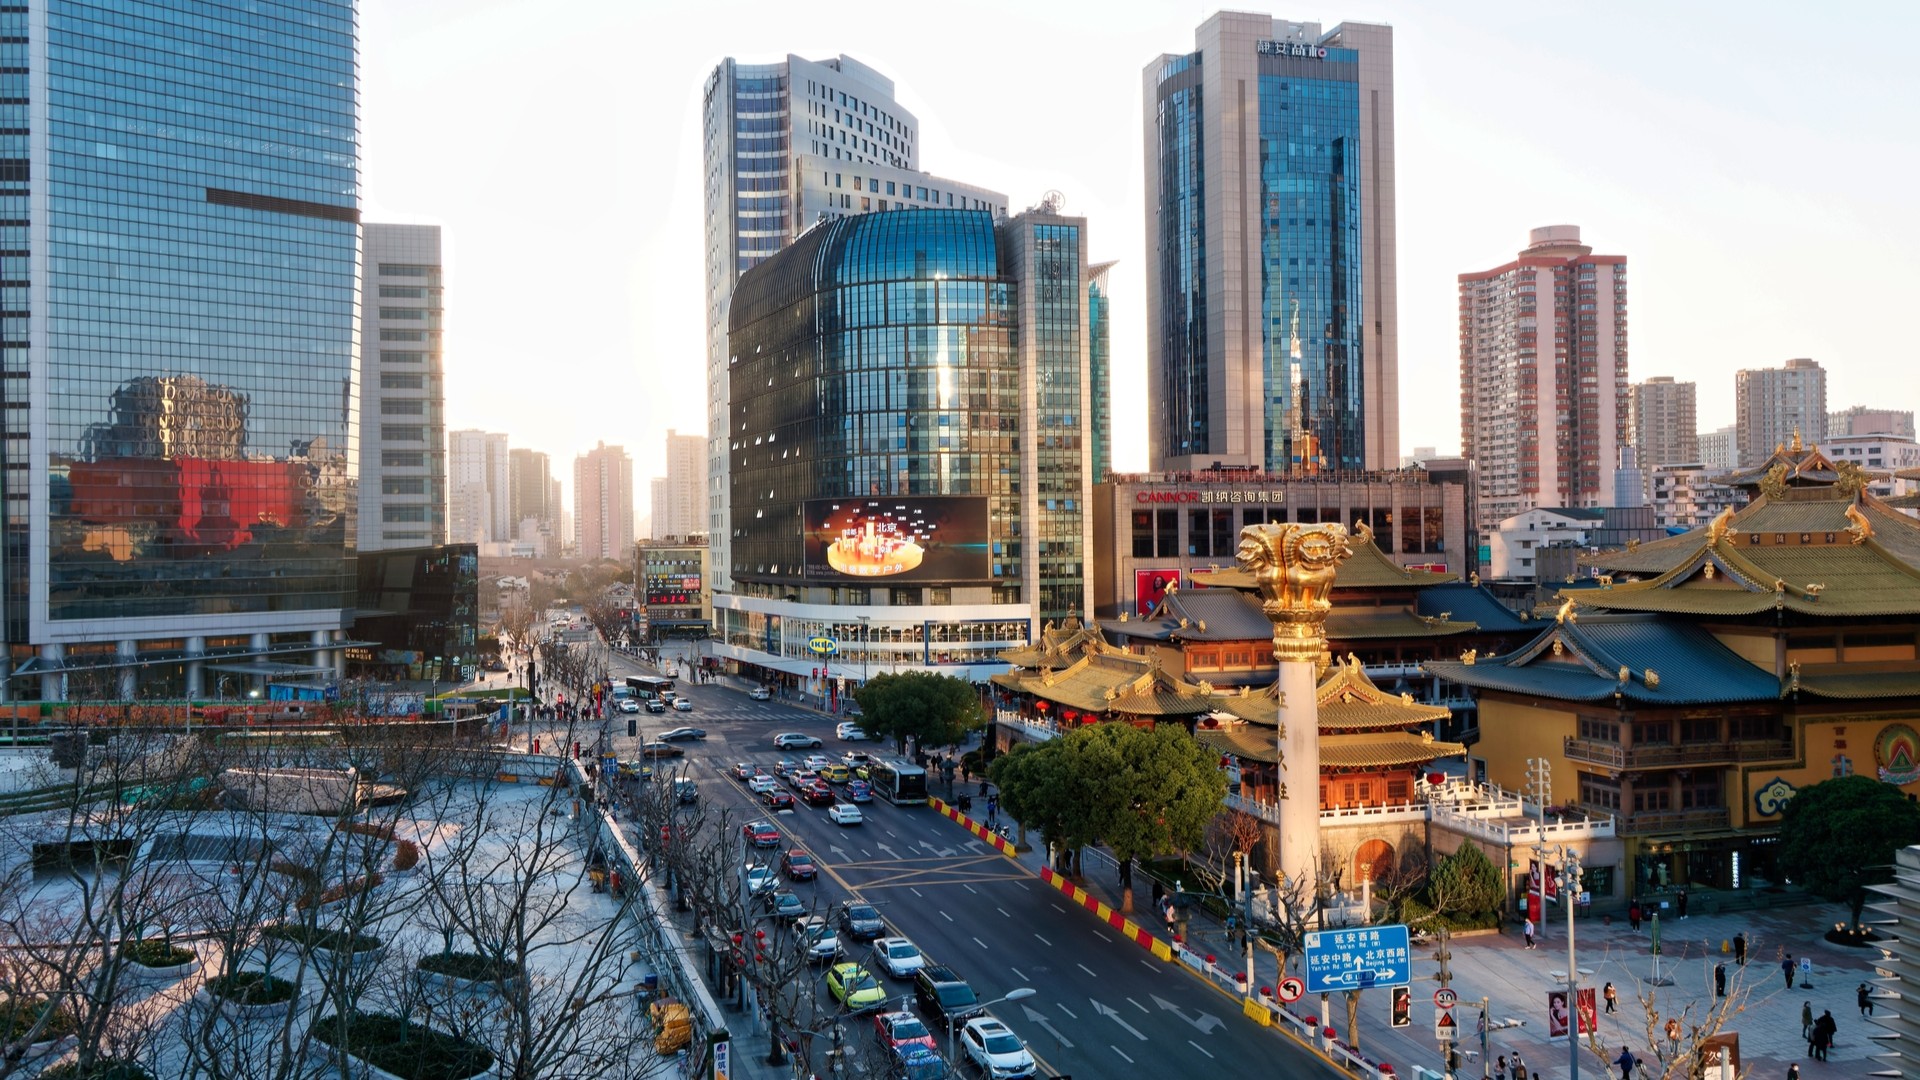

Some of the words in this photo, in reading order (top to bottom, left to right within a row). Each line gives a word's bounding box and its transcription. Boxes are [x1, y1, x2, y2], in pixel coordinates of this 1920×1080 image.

[1137, 491, 1198, 503] CANNOR
[1201, 491, 1283, 503] 凯纳咨询集团
[877, 522, 897, 532] 北京
[1334, 931, 1379, 944] 延安西路
[1310, 953, 1352, 965] 延安中路
[1366, 947, 1406, 959] 北京西路
[1345, 971, 1373, 981] 华山路
[1439, 993, 1453, 1003] 30
